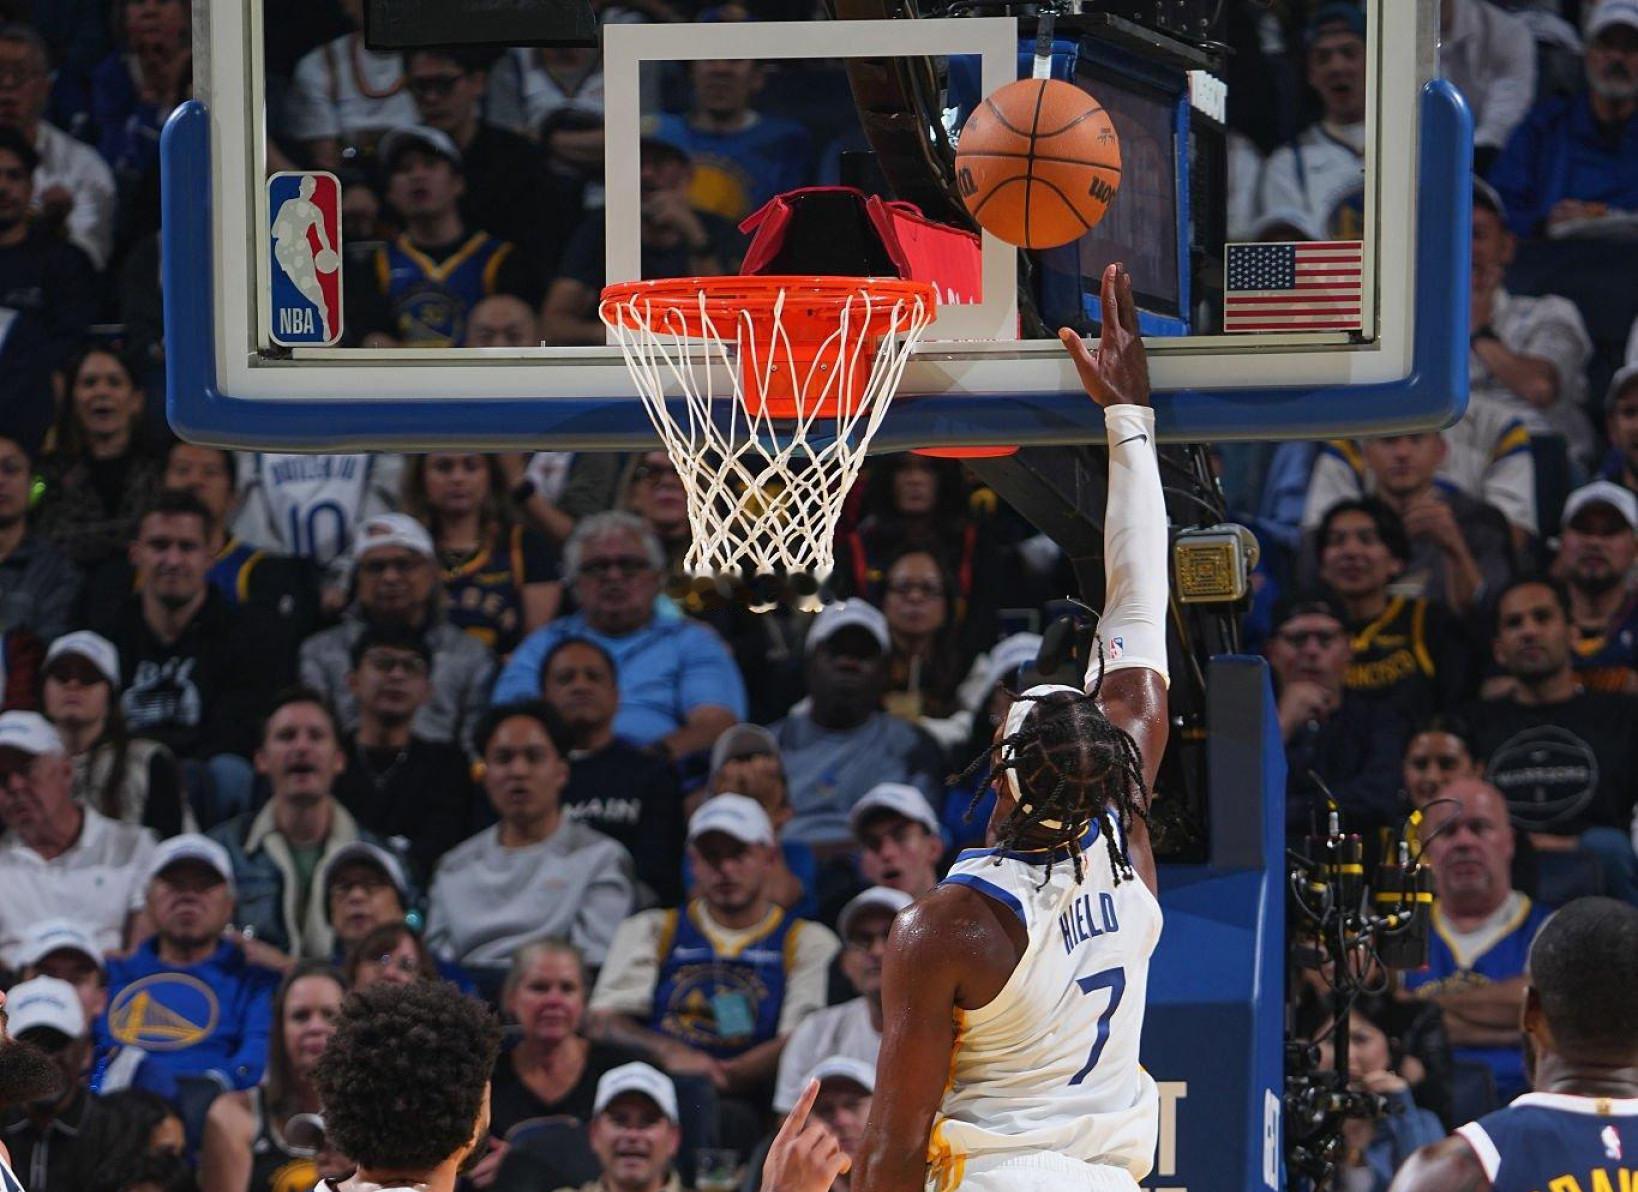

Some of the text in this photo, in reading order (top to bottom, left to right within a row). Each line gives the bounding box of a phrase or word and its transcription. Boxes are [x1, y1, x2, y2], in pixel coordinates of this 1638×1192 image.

[279, 307, 315, 334] NBA
[290, 501, 347, 571] 10
[1058, 892, 1119, 955] HIELD
[1068, 966, 1126, 1086] 7
